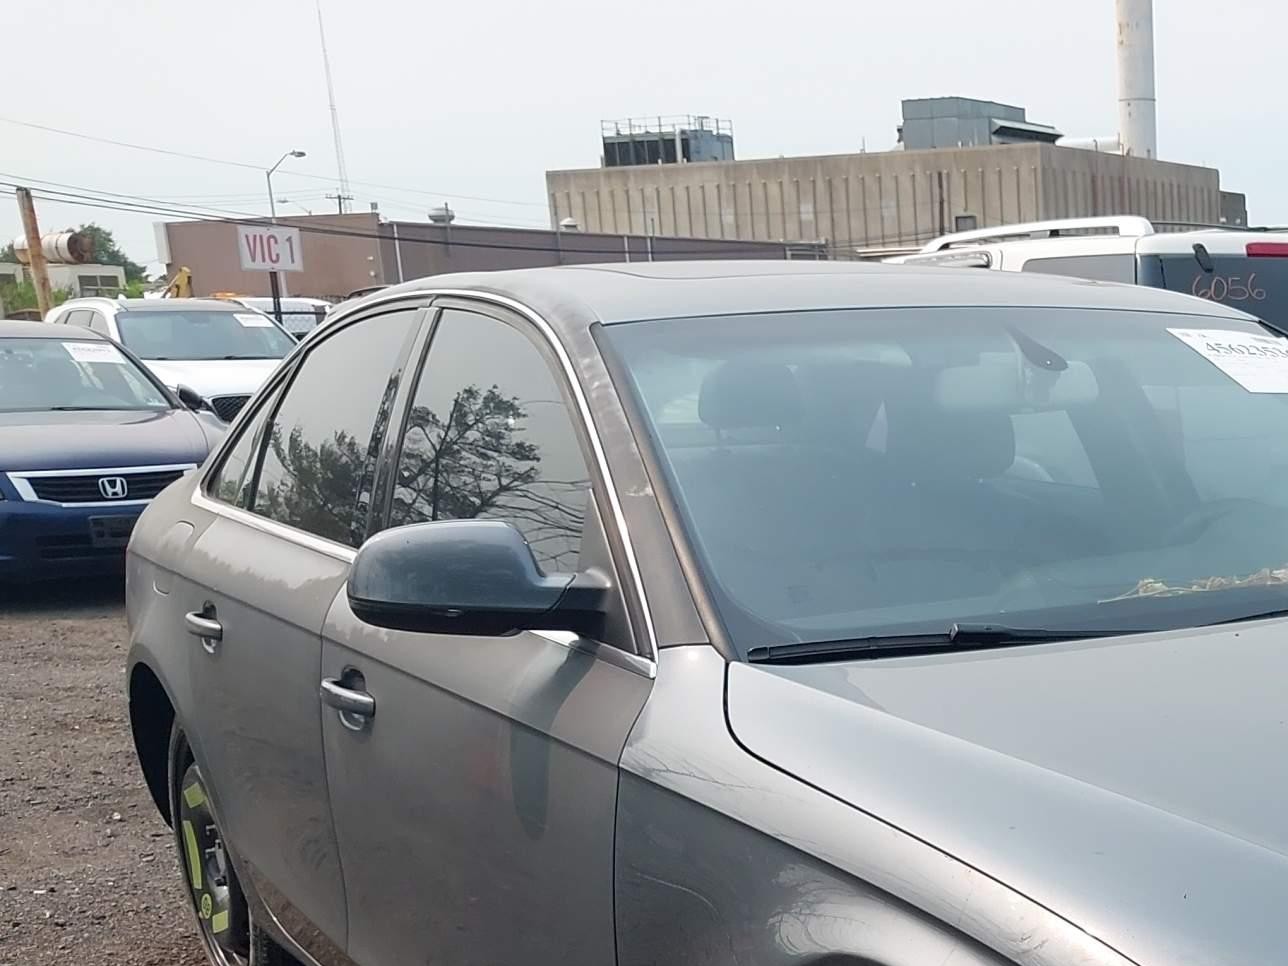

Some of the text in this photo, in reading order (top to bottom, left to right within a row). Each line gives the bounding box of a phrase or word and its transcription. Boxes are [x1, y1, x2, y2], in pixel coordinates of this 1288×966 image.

[245, 234, 295, 264] VIC 1
[1192, 273, 1266, 300] 6056
